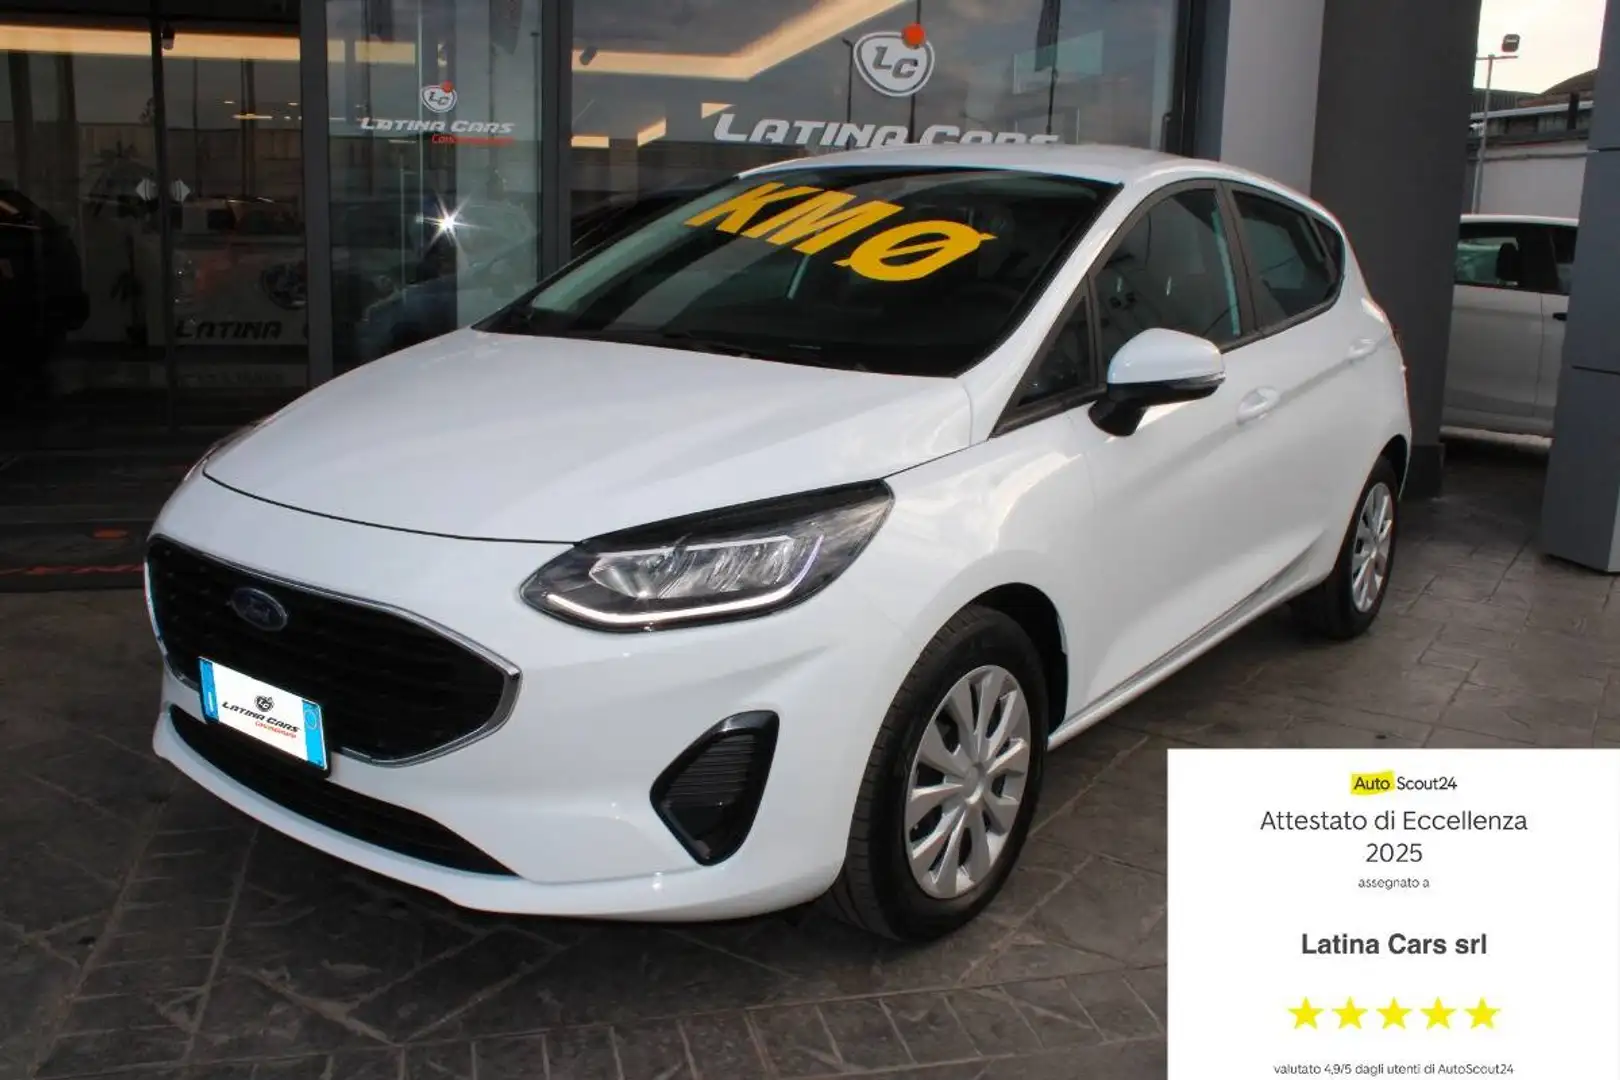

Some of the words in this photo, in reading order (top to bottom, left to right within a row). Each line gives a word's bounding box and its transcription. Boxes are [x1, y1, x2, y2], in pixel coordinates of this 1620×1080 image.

[871, 46, 919, 79] LC
[360, 117, 445, 132] LATINA
[451, 120, 515, 133] CARS
[713, 114, 911, 148] LATINA
[175, 320, 282, 340] LATINA
[222, 701, 265, 721] LATINA
[267, 717, 300, 733] CARS
